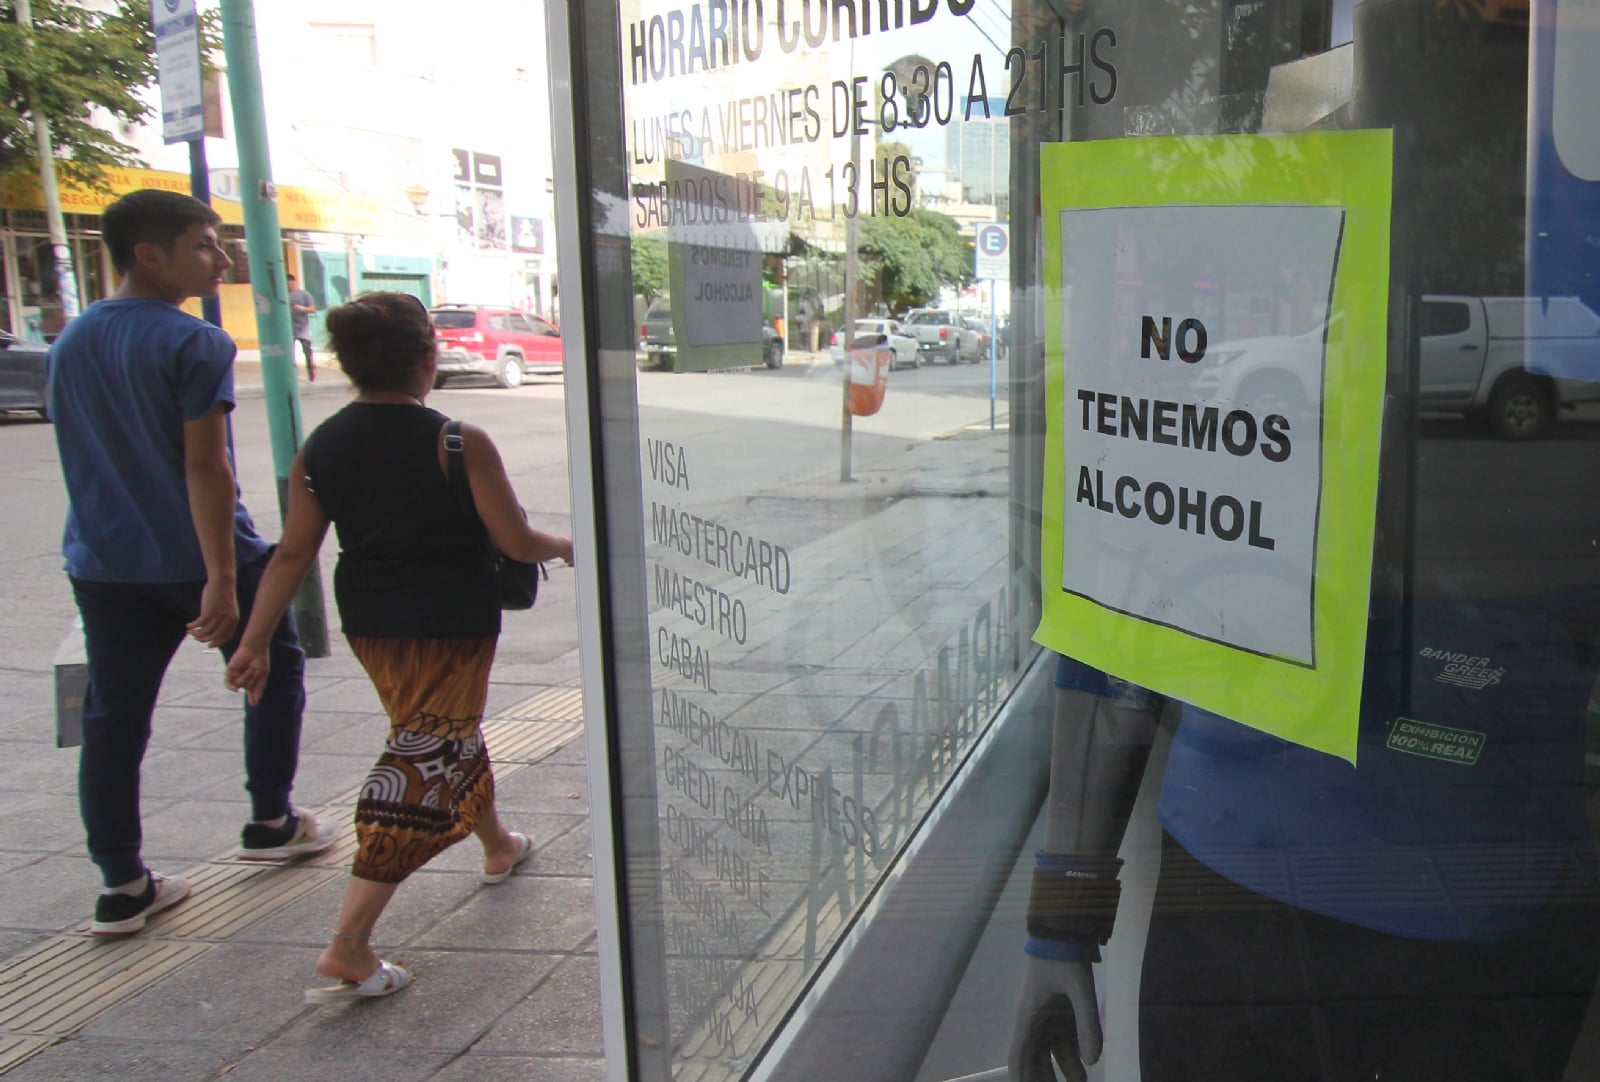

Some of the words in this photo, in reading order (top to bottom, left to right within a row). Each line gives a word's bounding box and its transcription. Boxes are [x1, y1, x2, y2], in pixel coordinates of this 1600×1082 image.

[630, 0, 764, 86] HORARIO
[633, 109, 694, 165] LUNES
[701, 106, 714, 156] A
[718, 84, 821, 154] VIERNES
[832, 76, 868, 138] DE
[964, 54, 991, 122] A
[636, 175, 728, 229] SABADOS
[736, 171, 767, 223] DE
[775, 169, 790, 222] 9
[797, 166, 816, 221] A
[825, 161, 858, 220] 13
[870, 155, 911, 218] HS
[986, 231, 1001, 251] E
[1140, 315, 1208, 363] NO
[1077, 388, 1292, 463] TENEMOS
[648, 437, 689, 491] VISA
[1076, 465, 1276, 551] ALCOHOL
[652, 501, 790, 595] MASTERCARD
[655, 563, 747, 645] MAESTRO
[658, 626, 718, 696] CABAL
[1419, 647, 1490, 668] BANDER
[661, 687, 759, 784] AMERICAN
[767, 748, 878, 857] EXPRESS
[1430, 743, 1475, 760] REAL
[664, 745, 717, 817] CREDI
[723, 786, 772, 856] GUIA
